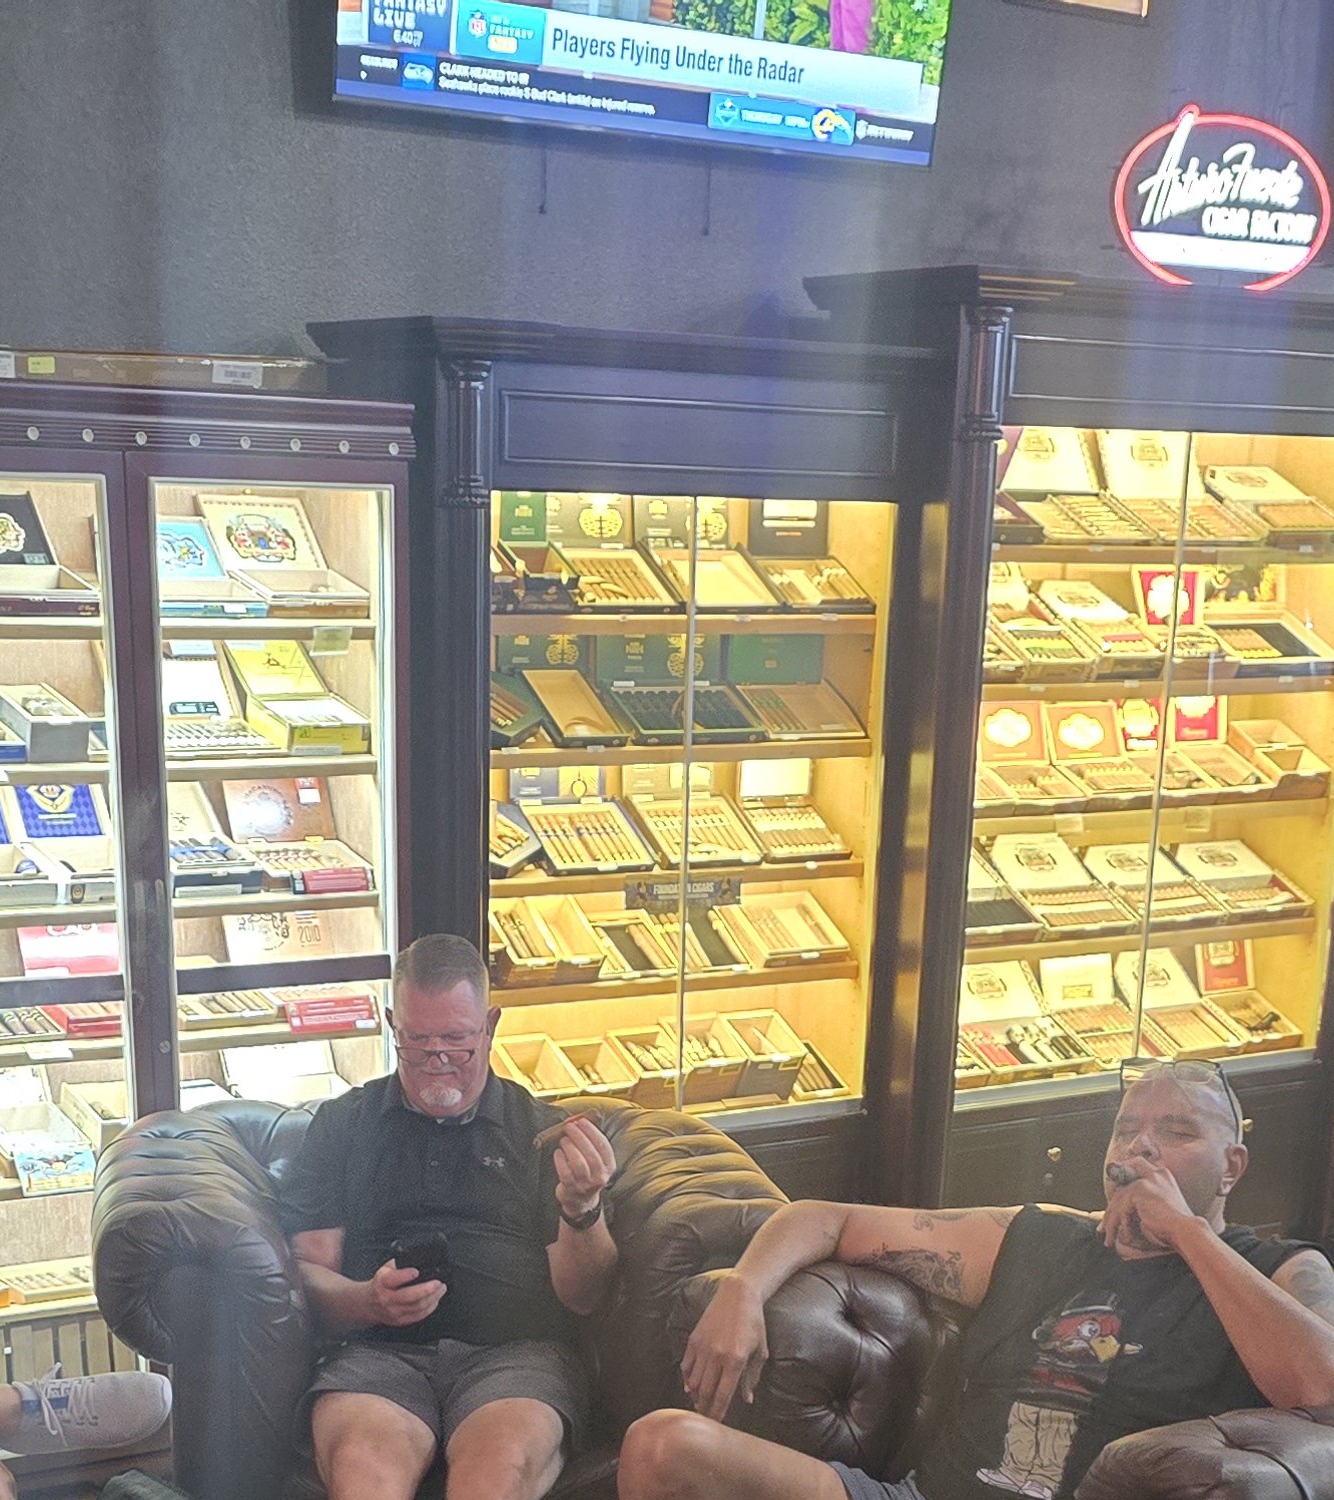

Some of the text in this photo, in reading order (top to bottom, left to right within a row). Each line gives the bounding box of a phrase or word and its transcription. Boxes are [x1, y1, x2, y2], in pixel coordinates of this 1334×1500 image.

[552, 28, 805, 84] Players Flying Under the Radar
